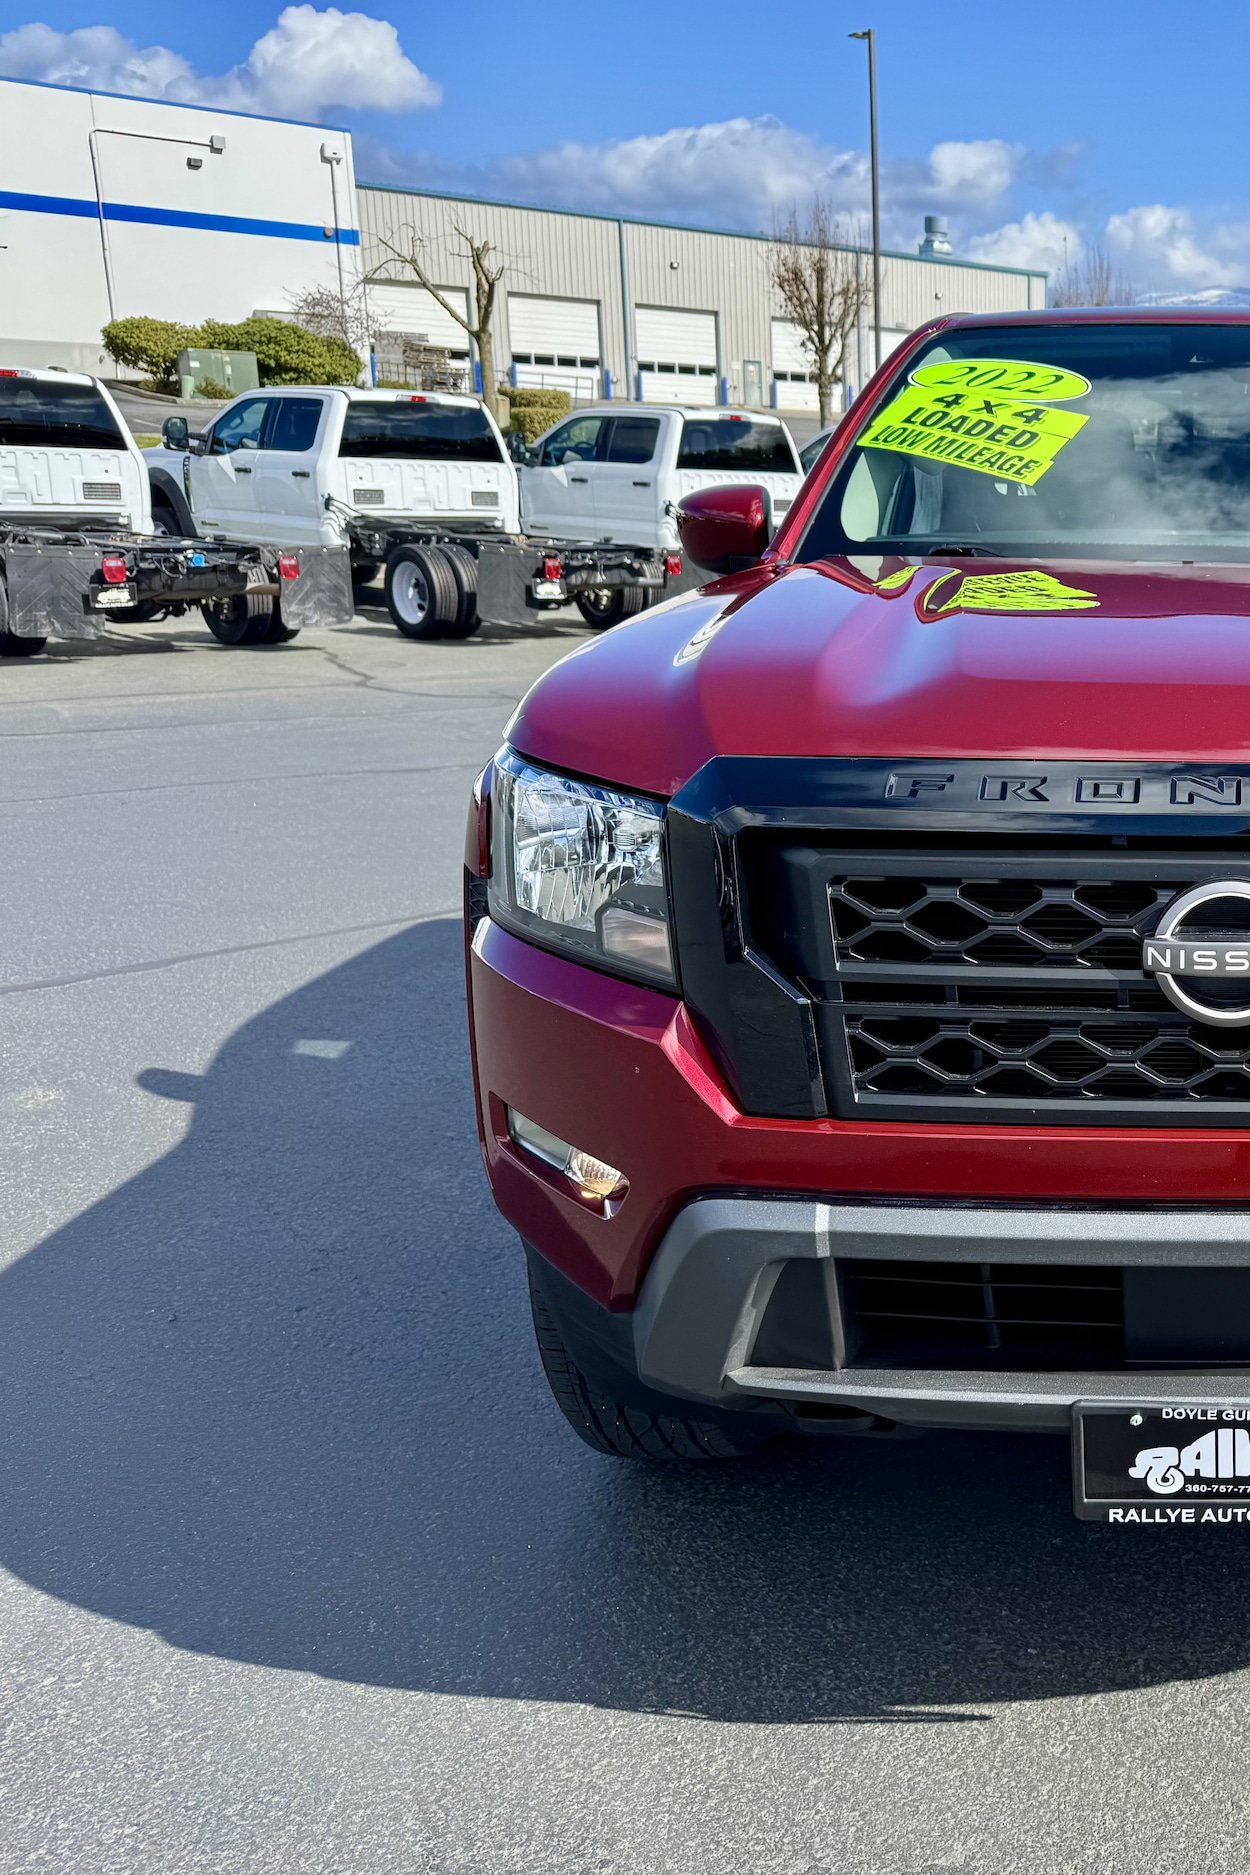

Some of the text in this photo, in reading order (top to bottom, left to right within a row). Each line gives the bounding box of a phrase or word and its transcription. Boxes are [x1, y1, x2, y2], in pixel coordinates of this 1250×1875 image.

[932, 366, 1065, 394] 2022
[931, 393, 970, 410] 4
[1012, 407, 1050, 427] 4
[901, 406, 1042, 451] LOADED
[869, 424, 1043, 480] LOW MILEAGE
[1162, 1407, 1218, 1421] DOYLE
[1108, 1507, 1196, 1523] RALLYE
